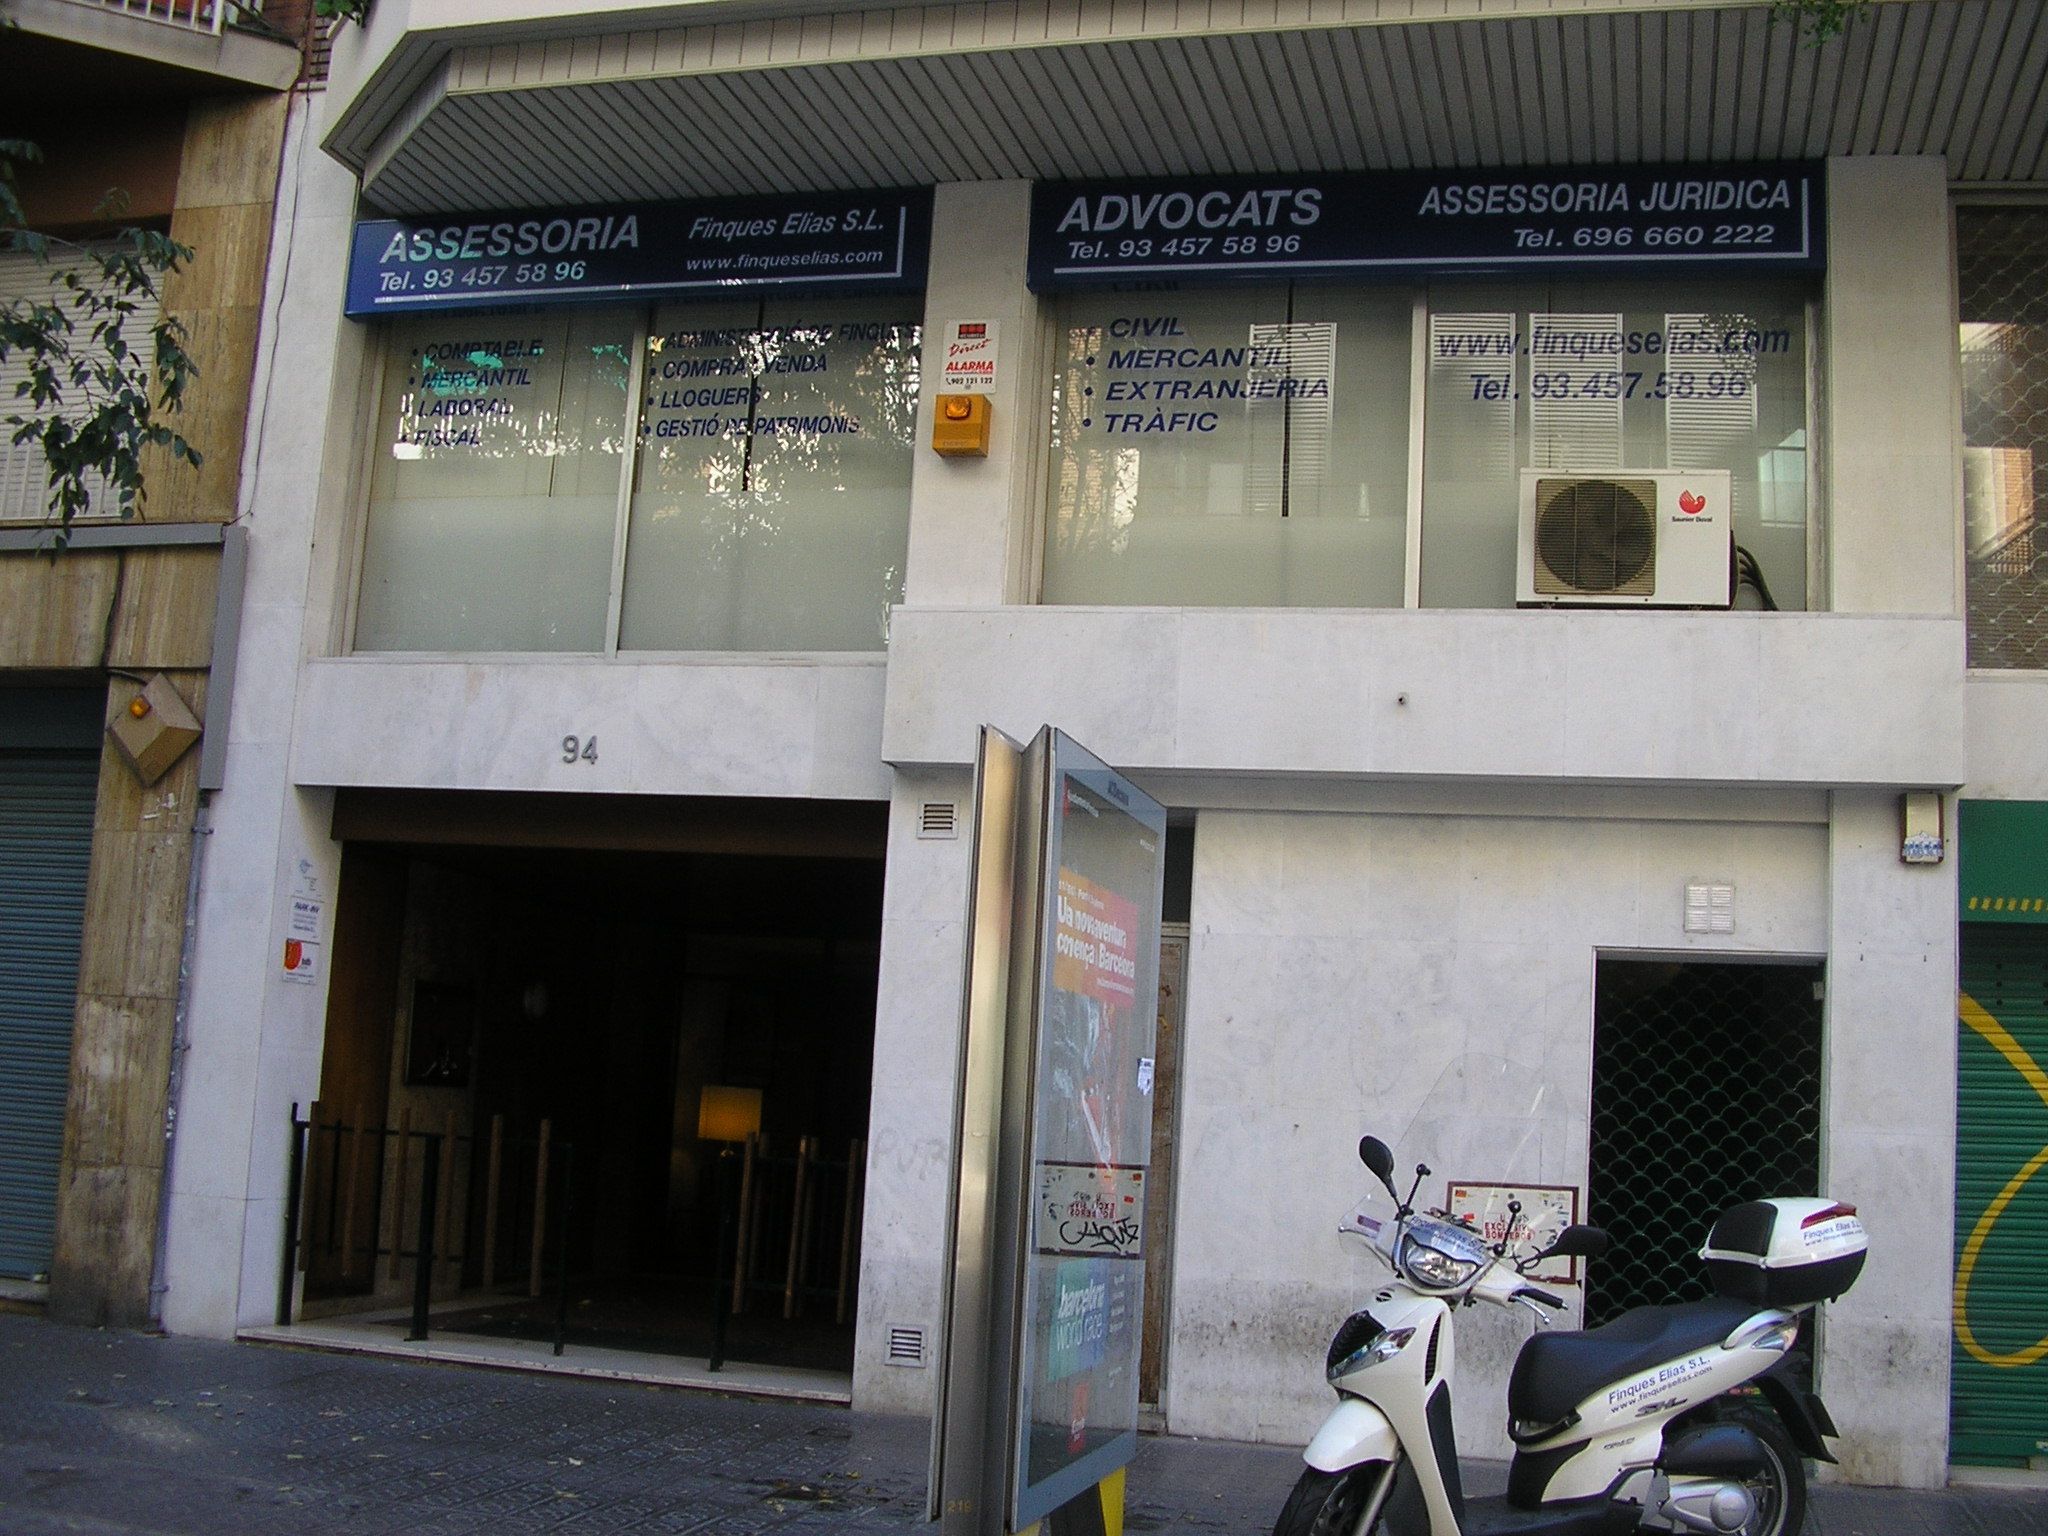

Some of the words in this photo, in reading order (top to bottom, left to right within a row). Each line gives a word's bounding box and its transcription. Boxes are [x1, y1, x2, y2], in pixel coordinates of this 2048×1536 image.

[1419, 182, 1629, 215] ASSESSORIA
[1640, 179, 1790, 211] JURIDICA
[1057, 188, 1322, 233] ADVOCATS
[689, 217, 777, 242] Finques
[782, 212, 837, 234] Elias
[842, 209, 884, 231] S.L.
[1513, 228, 1563, 248] Tel.
[1573, 227, 1632, 246] 696
[1643, 226, 1704, 245] 660
[1712, 225, 1775, 244] 222
[379, 215, 639, 263] ASSESSORIA
[1068, 241, 1110, 260] Tel.
[1118, 239, 1151, 258] 93
[1160, 238, 1212, 257] 457
[1222, 236, 1257, 255] 58
[1266, 235, 1300, 253] 96
[686, 250, 883, 272] www.finqueselias.com
[380, 271, 416, 291] Tel.
[423, 268, 454, 289] 93
[461, 265, 508, 286] 457
[515, 263, 547, 283] 58
[554, 261, 586, 281] 96
[1109, 318, 1185, 338] CIVIL
[425, 339, 544, 361] COMPTABLE
[1437, 326, 1790, 361] www.finqueselias.com
[946, 361, 993, 372] ALARMA
[1107, 346, 1293, 370] MERCANTIL
[421, 368, 531, 389] MERCANTIL
[1470, 373, 1519, 400] Tel.
[418, 398, 511, 418] LABORAL
[660, 386, 762, 409] LLOGUERS
[656, 413, 719, 437] GESTIÓ
[754, 415, 860, 436] PATRIMONIS
[1105, 407, 1219, 433] TRÀFIC
[414, 428, 480, 447] FISCAL
[562, 735, 598, 765] 94
[1485, 1231, 1532, 1240] BOMEROS
[1608, 1377, 1656, 1404] Finques
[1659, 1364, 1686, 1381] Elias
